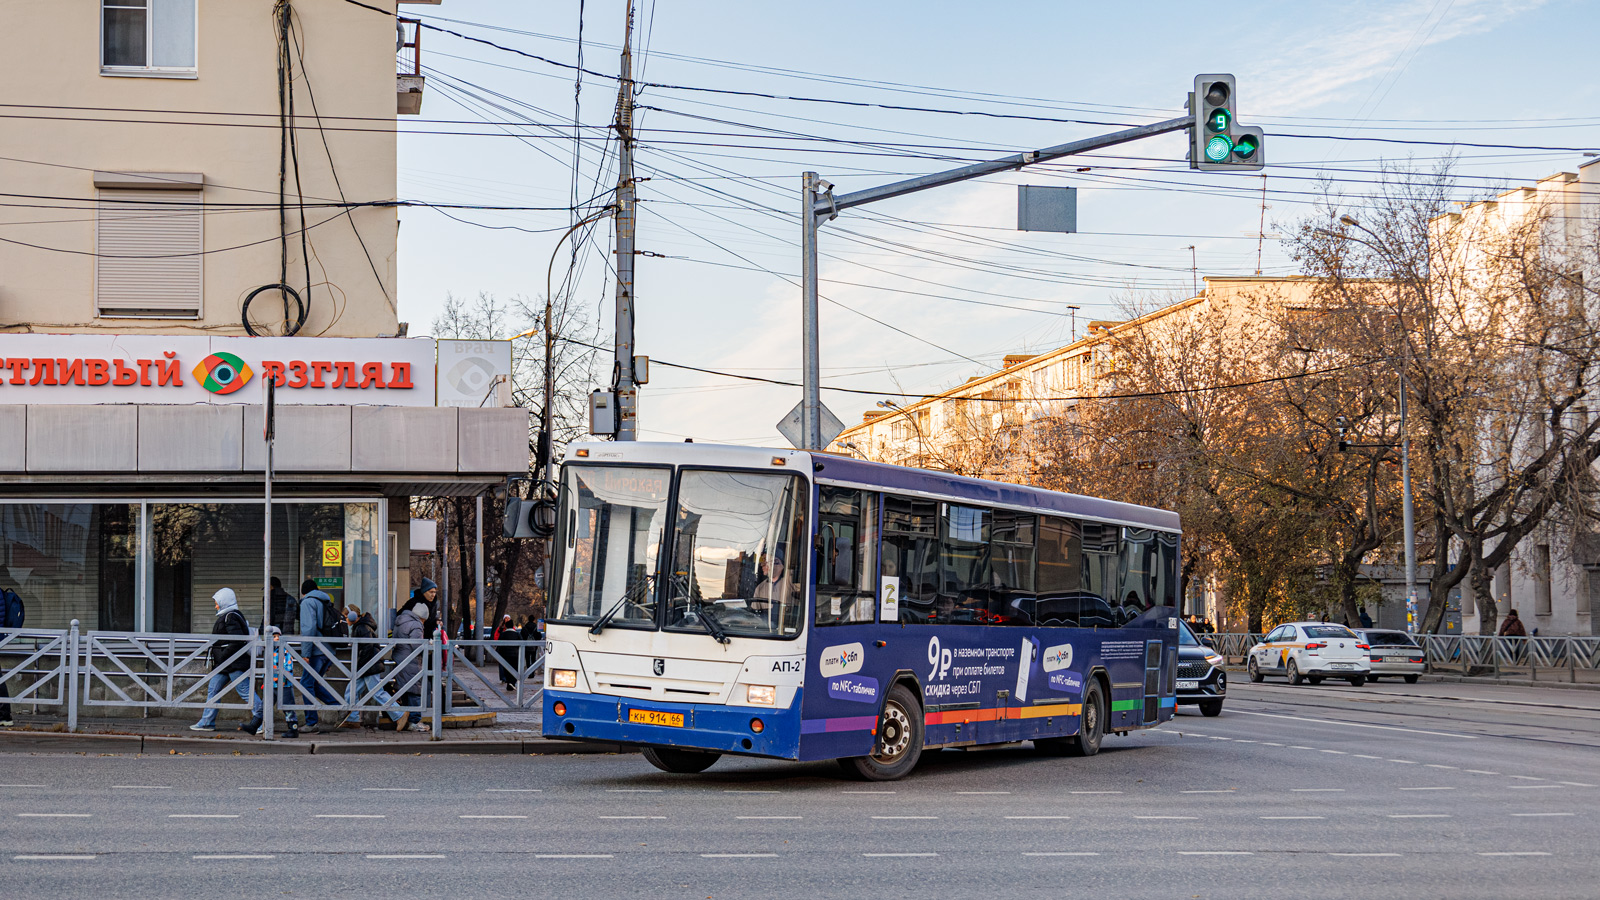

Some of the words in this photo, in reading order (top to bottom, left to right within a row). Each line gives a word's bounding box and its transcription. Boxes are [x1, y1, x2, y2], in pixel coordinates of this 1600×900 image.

[1216, 115, 1226, 130] 9
[0, 351, 184, 387] ТЛИВЫЙ
[825, 657, 839, 665] плати
[847, 651, 858, 662] сбп
[953, 648, 958, 658] в
[958, 648, 985, 658] наземном
[985, 648, 1015, 660] транспорте
[771, 661, 801, 672] АП-2
[952, 666, 964, 679] при
[964, 666, 983, 676] оплате
[983, 662, 1005, 676] билетов
[831, 682, 840, 691] по
[840, 680, 876, 696] NFC-табличке
[925, 683, 951, 698] скидка
[951, 685, 968, 698] через
[968, 680, 981, 694] СБП
[649, 713, 667, 724] 914
[671, 714, 681, 723] 66
